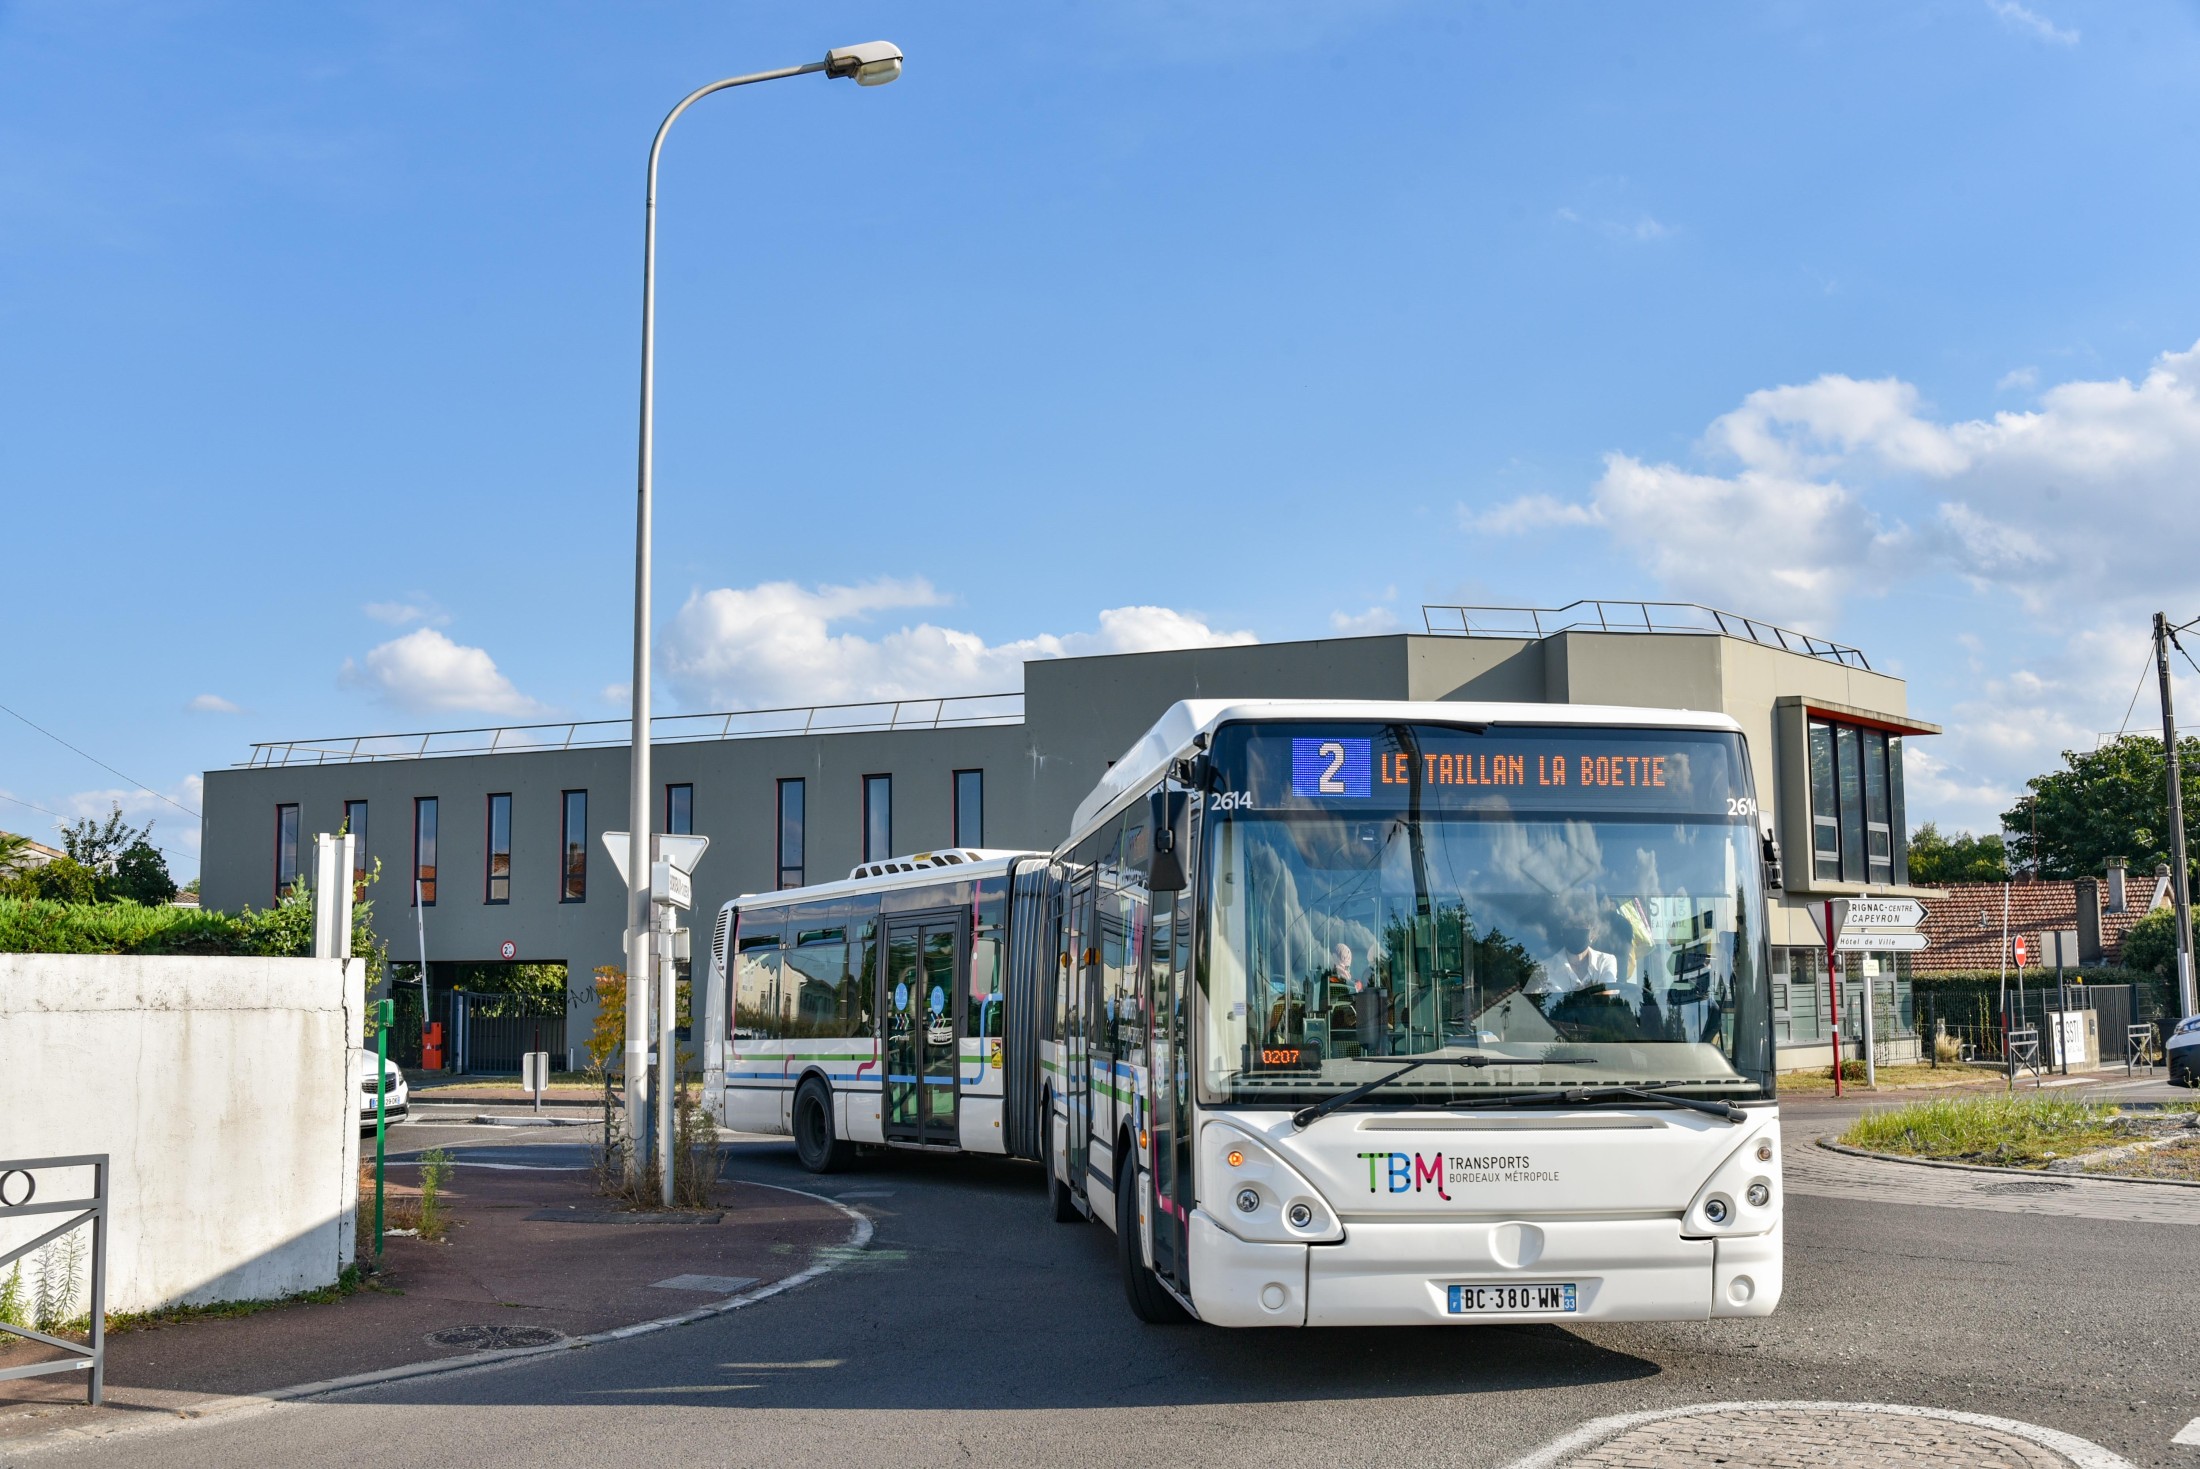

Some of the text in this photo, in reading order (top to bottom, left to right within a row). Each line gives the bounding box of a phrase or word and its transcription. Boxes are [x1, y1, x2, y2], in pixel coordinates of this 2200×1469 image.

[1319, 742, 1665, 793] 2 LE TAILLAN LA BOETIE
[1211, 791, 1253, 810] 2614
[1726, 797, 1757, 817] 2614
[1848, 903, 1913, 912] RIGNAC-CENTRE
[1851, 914, 1900, 923] CAPEYRON
[1840, 937, 1860, 945] Hôtel
[1263, 1050, 1299, 1064] 0207
[1357, 1152, 1530, 1201] TBM TRANSPORTS
[1449, 1171, 1559, 1183] BORDEAUX MÉTROPOLE
[1465, 1288, 1559, 1309] BC-380-WN
[1564, 1299, 1575, 1309] 33
